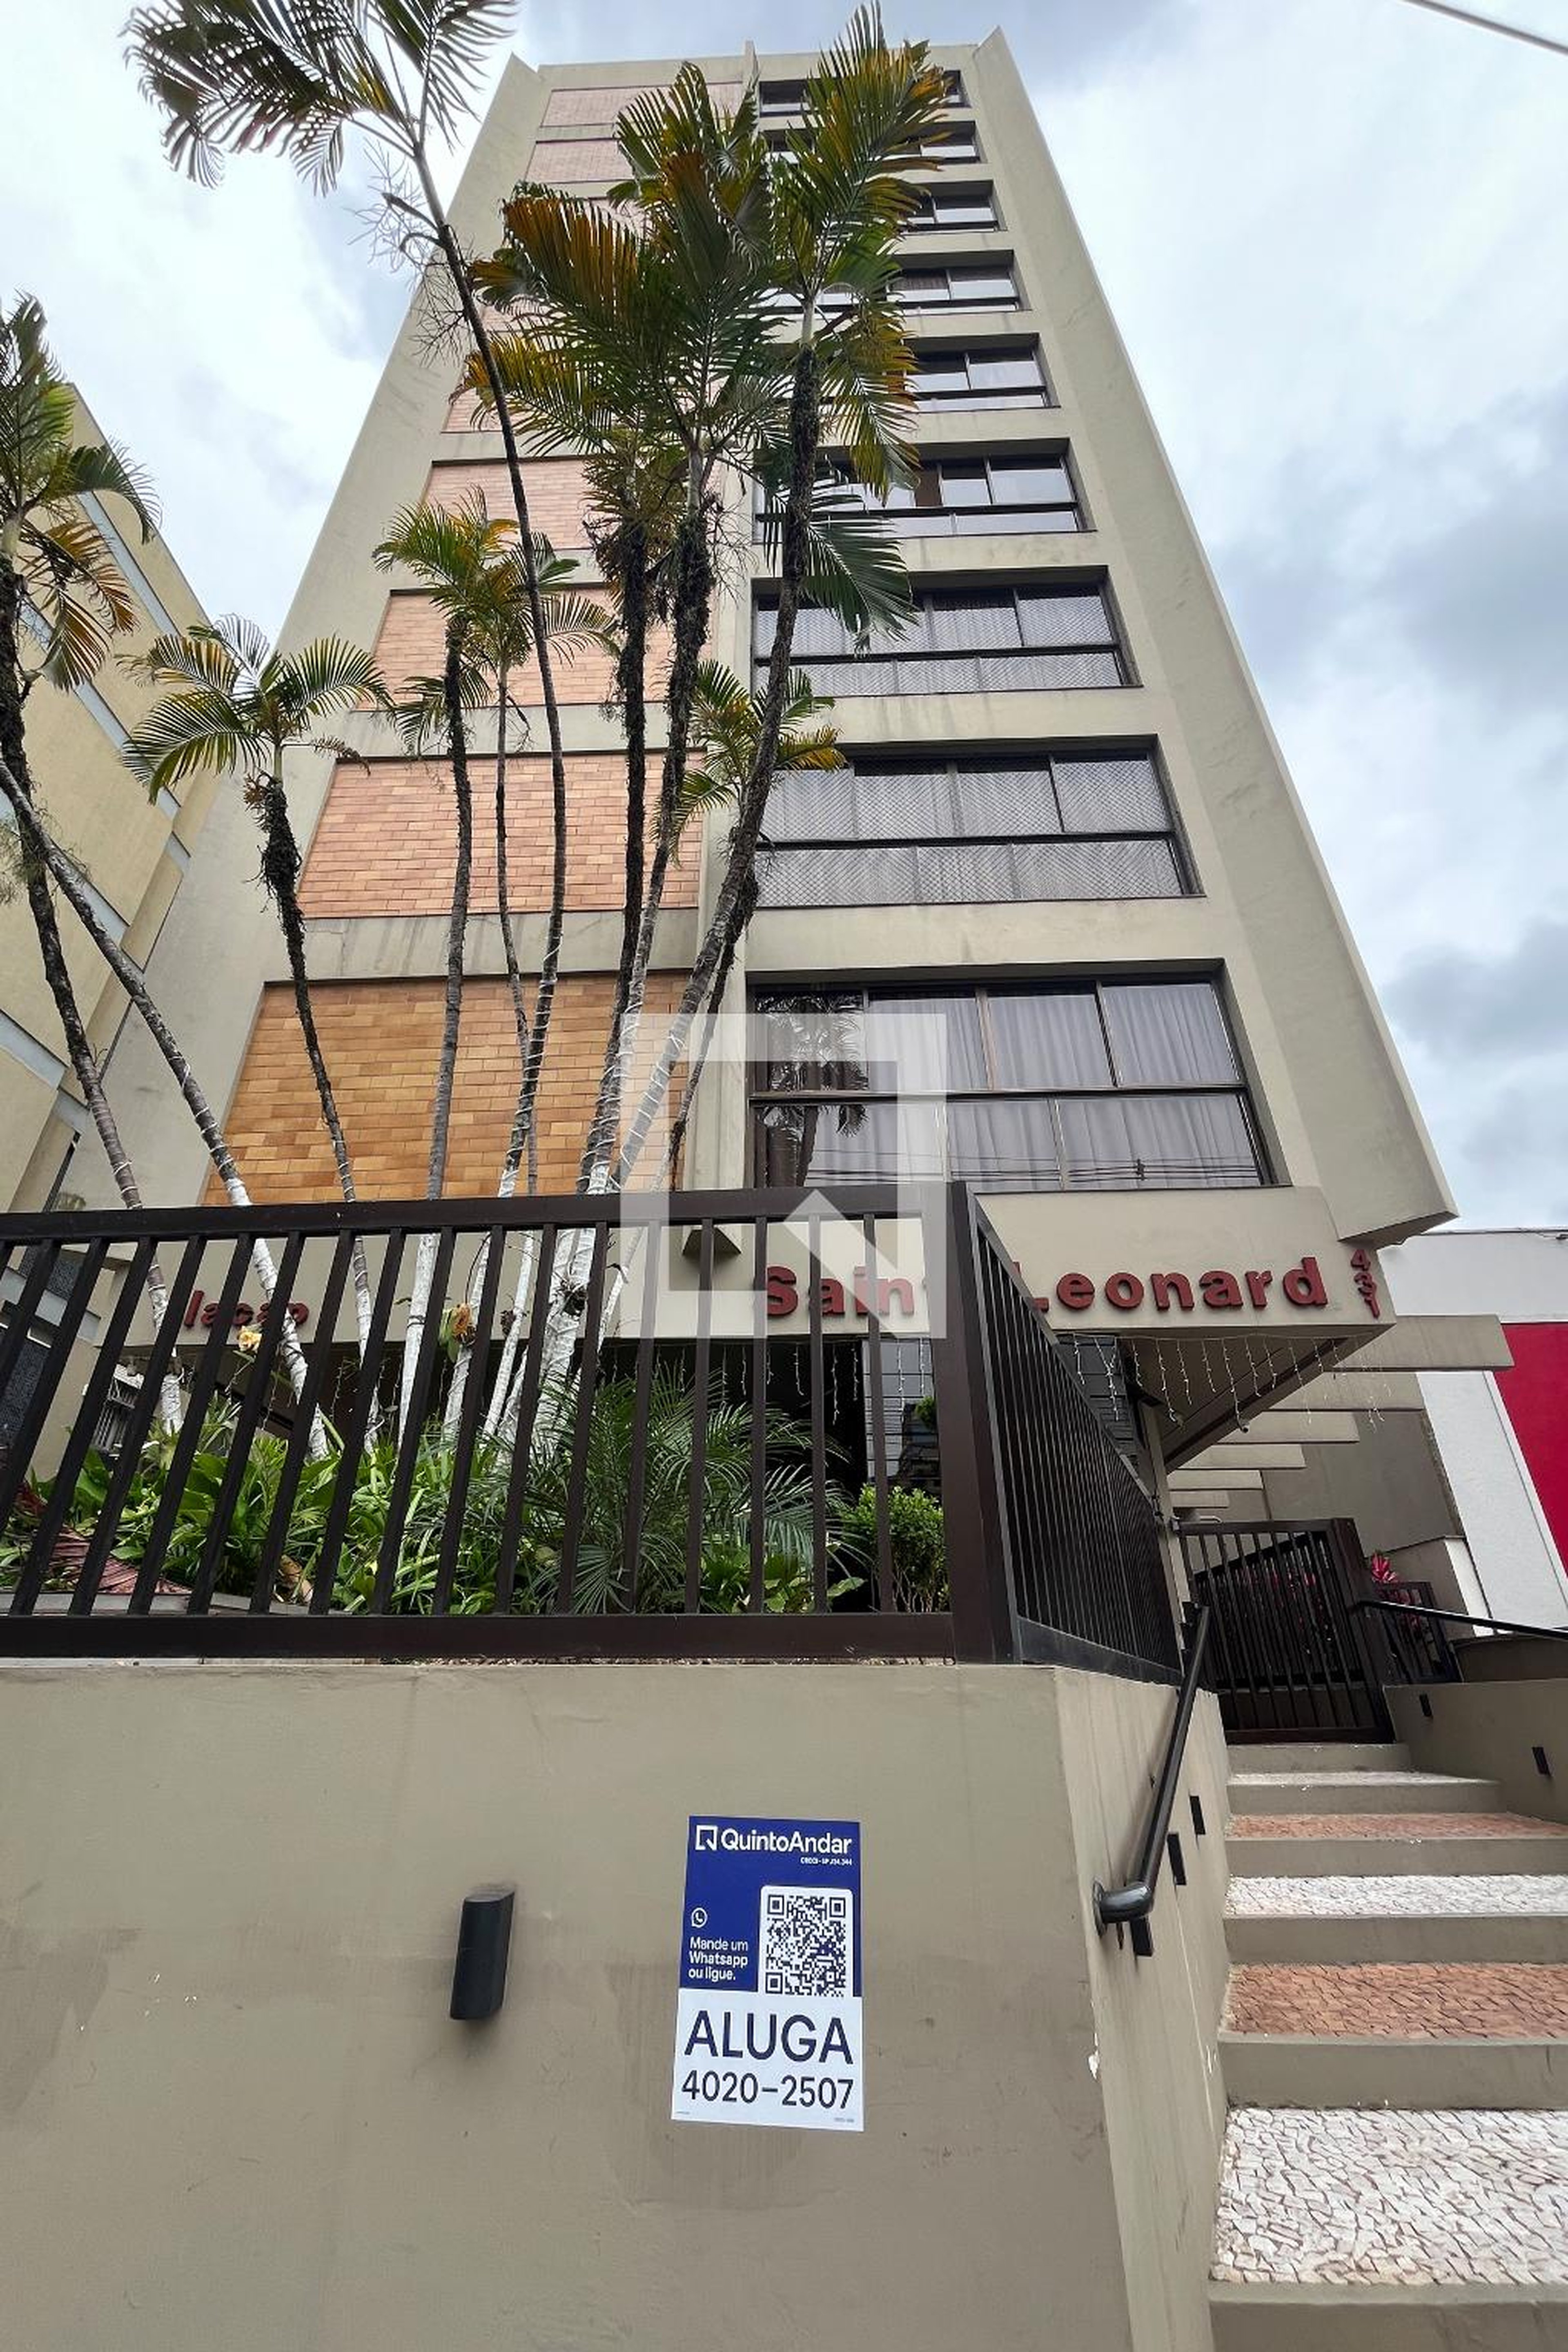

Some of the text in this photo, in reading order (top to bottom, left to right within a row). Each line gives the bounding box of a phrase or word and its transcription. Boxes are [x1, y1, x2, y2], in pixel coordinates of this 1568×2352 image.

[767, 1256, 1328, 1316] Sain eonard
[721, 1828, 853, 1854] QuintoAndar
[690, 1936, 748, 1951] Mande um
[689, 1950, 748, 1968] Whatsapp
[688, 1966, 736, 1982] ou ligue.
[684, 2010, 853, 2065] ALUGA
[681, 2069, 854, 2109] 4020-2507
